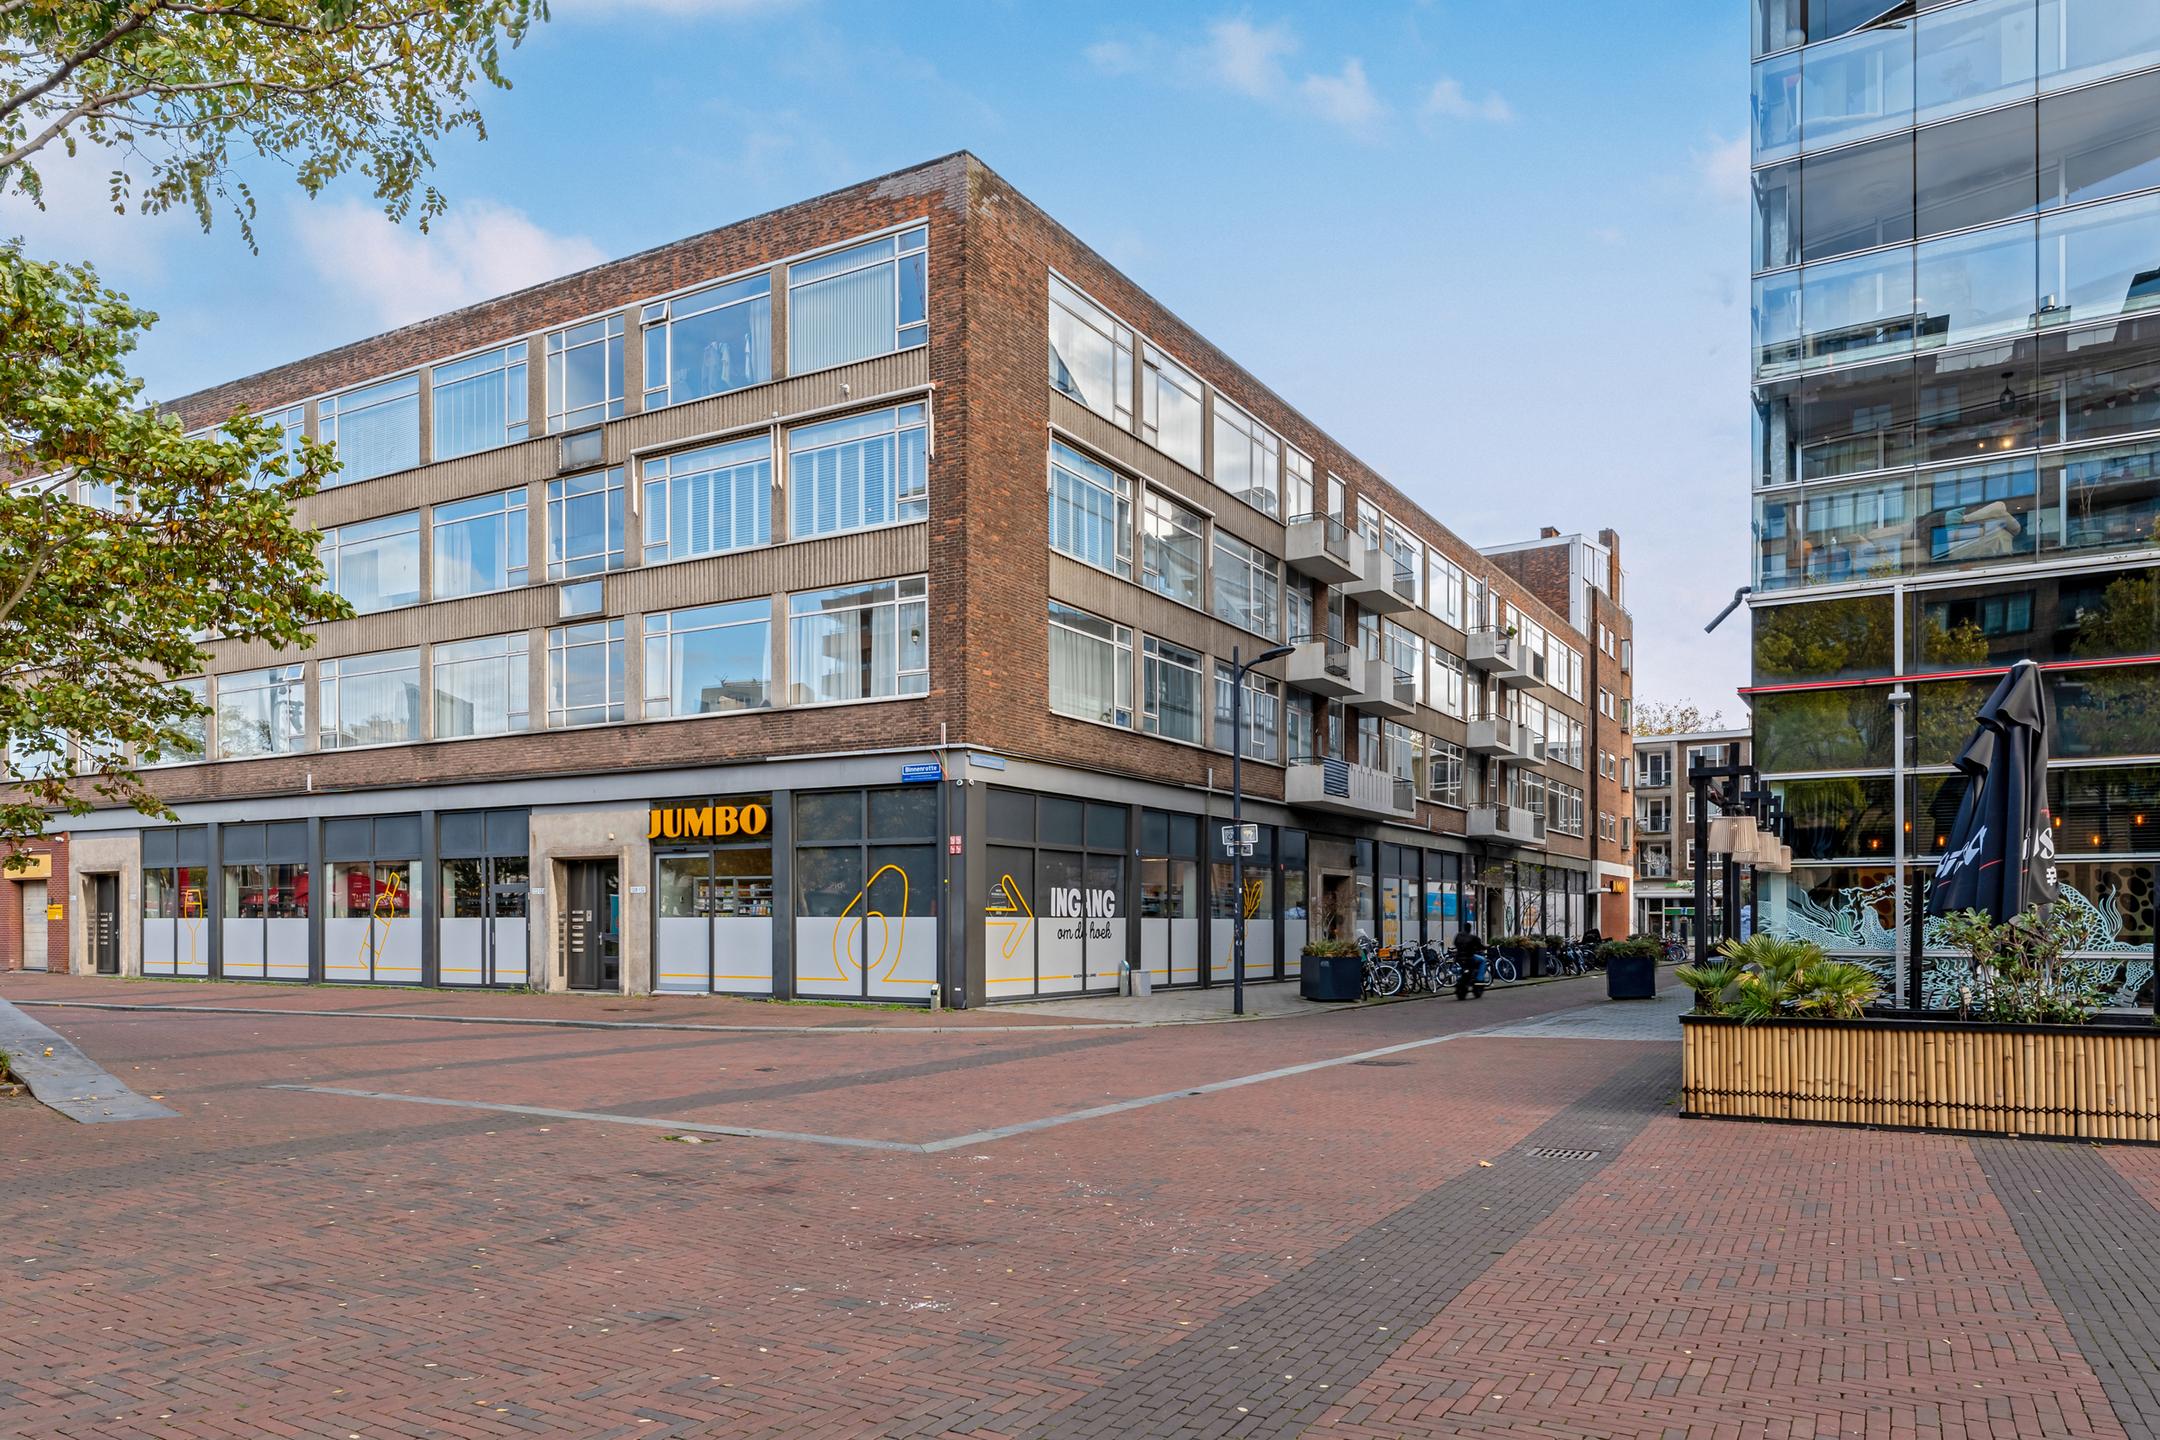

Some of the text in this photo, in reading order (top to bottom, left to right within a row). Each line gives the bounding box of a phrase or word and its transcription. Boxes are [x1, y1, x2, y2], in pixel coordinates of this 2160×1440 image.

[904, 765, 938, 773] Binnenrotte
[647, 803, 767, 839] JUMBO
[1050, 887, 1116, 918] INGANG
[1057, 921, 1112, 940] om d hoek
